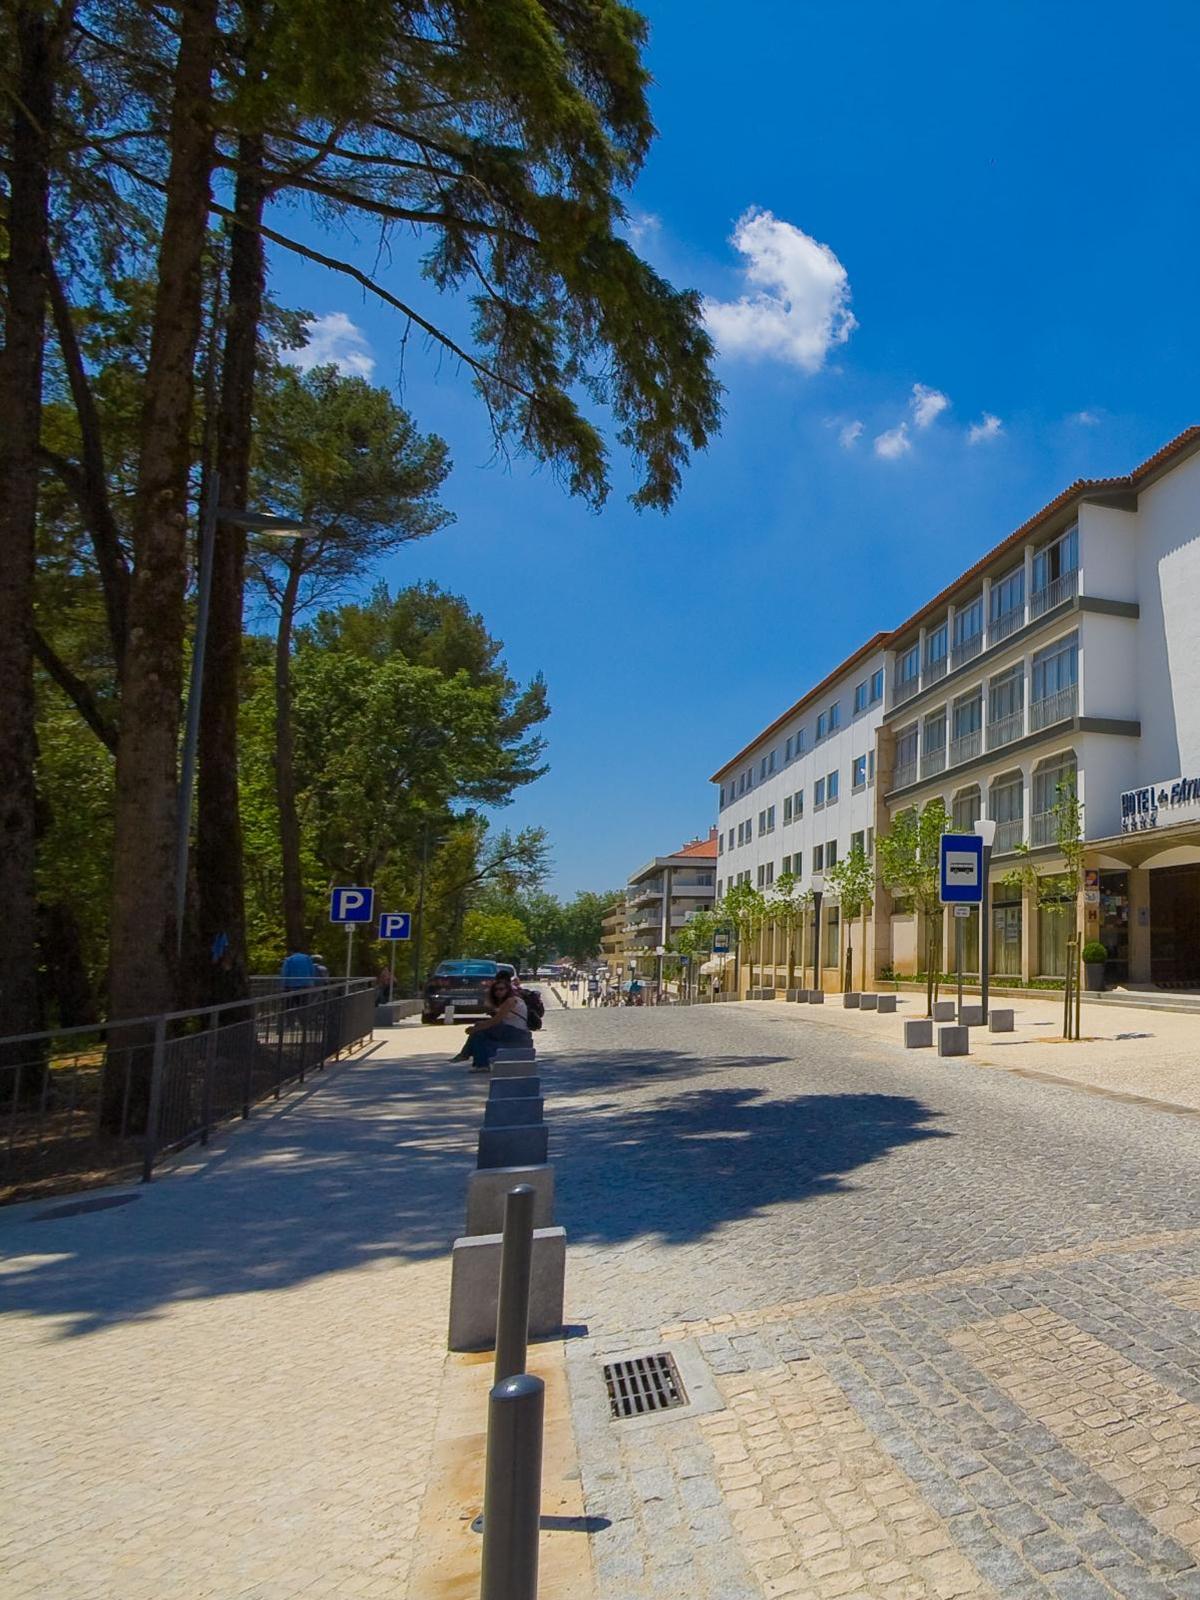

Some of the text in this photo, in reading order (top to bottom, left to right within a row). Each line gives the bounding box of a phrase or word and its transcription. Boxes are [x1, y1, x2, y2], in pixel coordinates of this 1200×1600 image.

[1121, 787, 1157, 818] HOTEL
[339, 891, 365, 919] P
[385, 916, 404, 937] P
